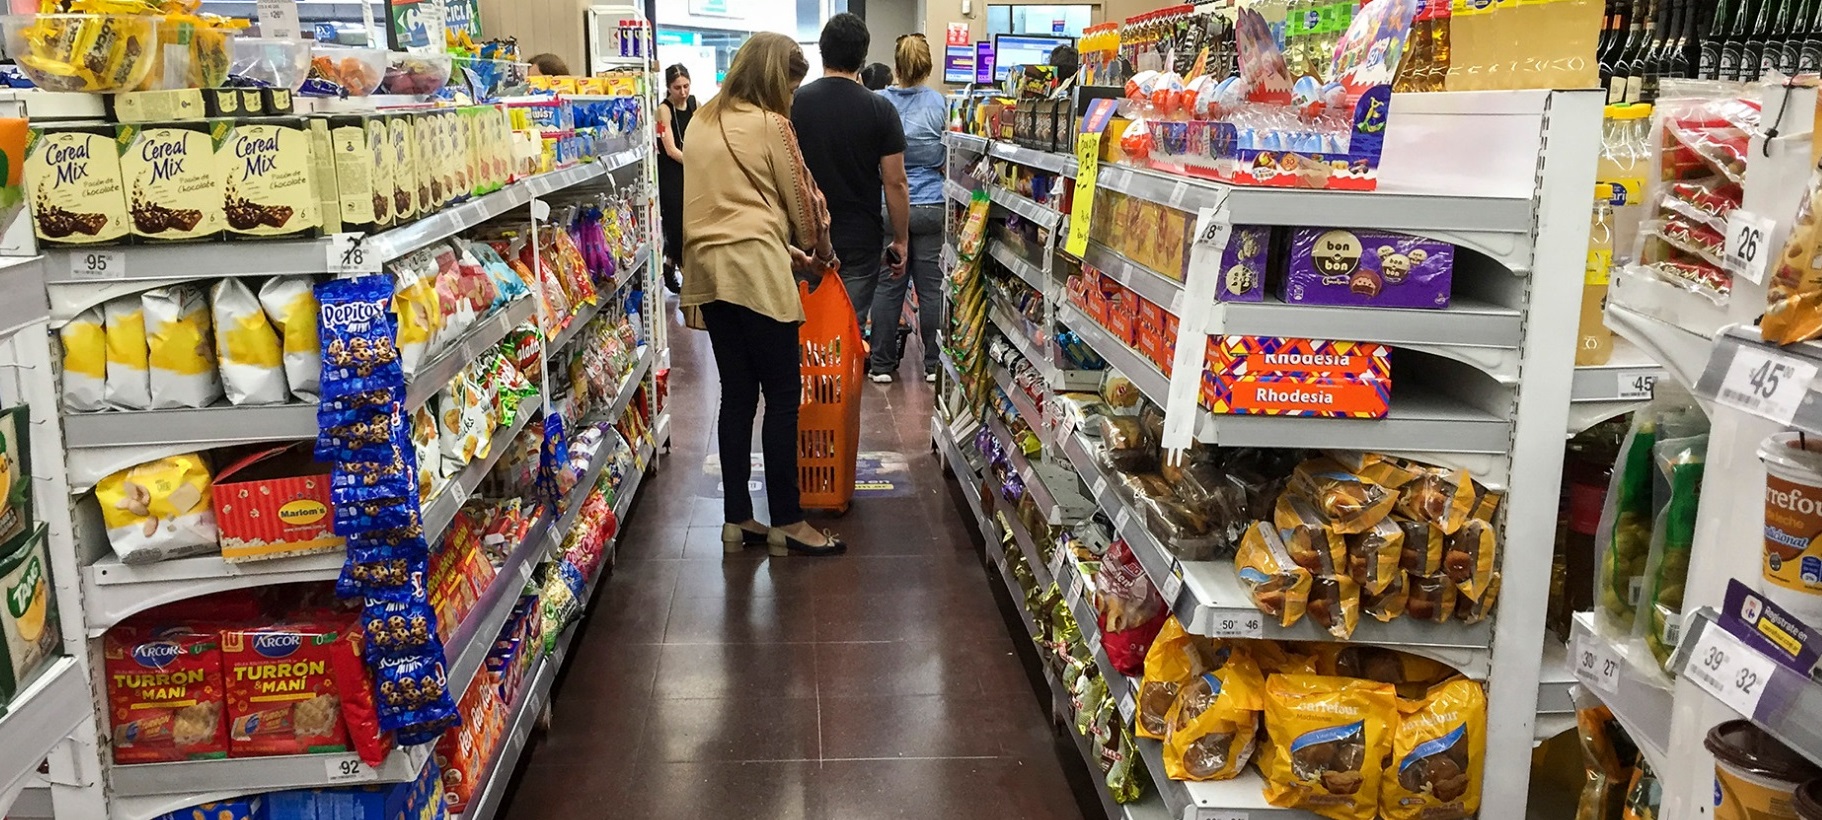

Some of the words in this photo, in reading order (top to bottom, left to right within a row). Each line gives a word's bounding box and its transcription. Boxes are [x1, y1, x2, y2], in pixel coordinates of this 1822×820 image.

[46, 135, 92, 166] Cereal
[142, 132, 188, 162] Cereal
[235, 128, 282, 158] Cereal
[53, 162, 88, 190] Mix
[150, 158, 185, 186] Mix
[242, 154, 277, 182] Mix
[1327, 241, 1350, 251] bon
[1325, 260, 1349, 271] bon
[1385, 269, 1400, 277] bon
[1389, 258, 1403, 266] bon
[322, 301, 382, 328] Pepitos
[1265, 353, 1350, 366] Rhodesia
[1256, 387, 1333, 404] Rhodesia
[12, 561, 39, 614] TANG
[1764, 605, 1800, 637] Registrate
[1797, 631, 1808, 642] en
[253, 633, 300, 649] ARCOR
[113, 667, 204, 689] TURRÓN
[233, 658, 326, 682] TURRÓN
[142, 683, 187, 700] MANÍ
[262, 676, 306, 693] MANÍ
